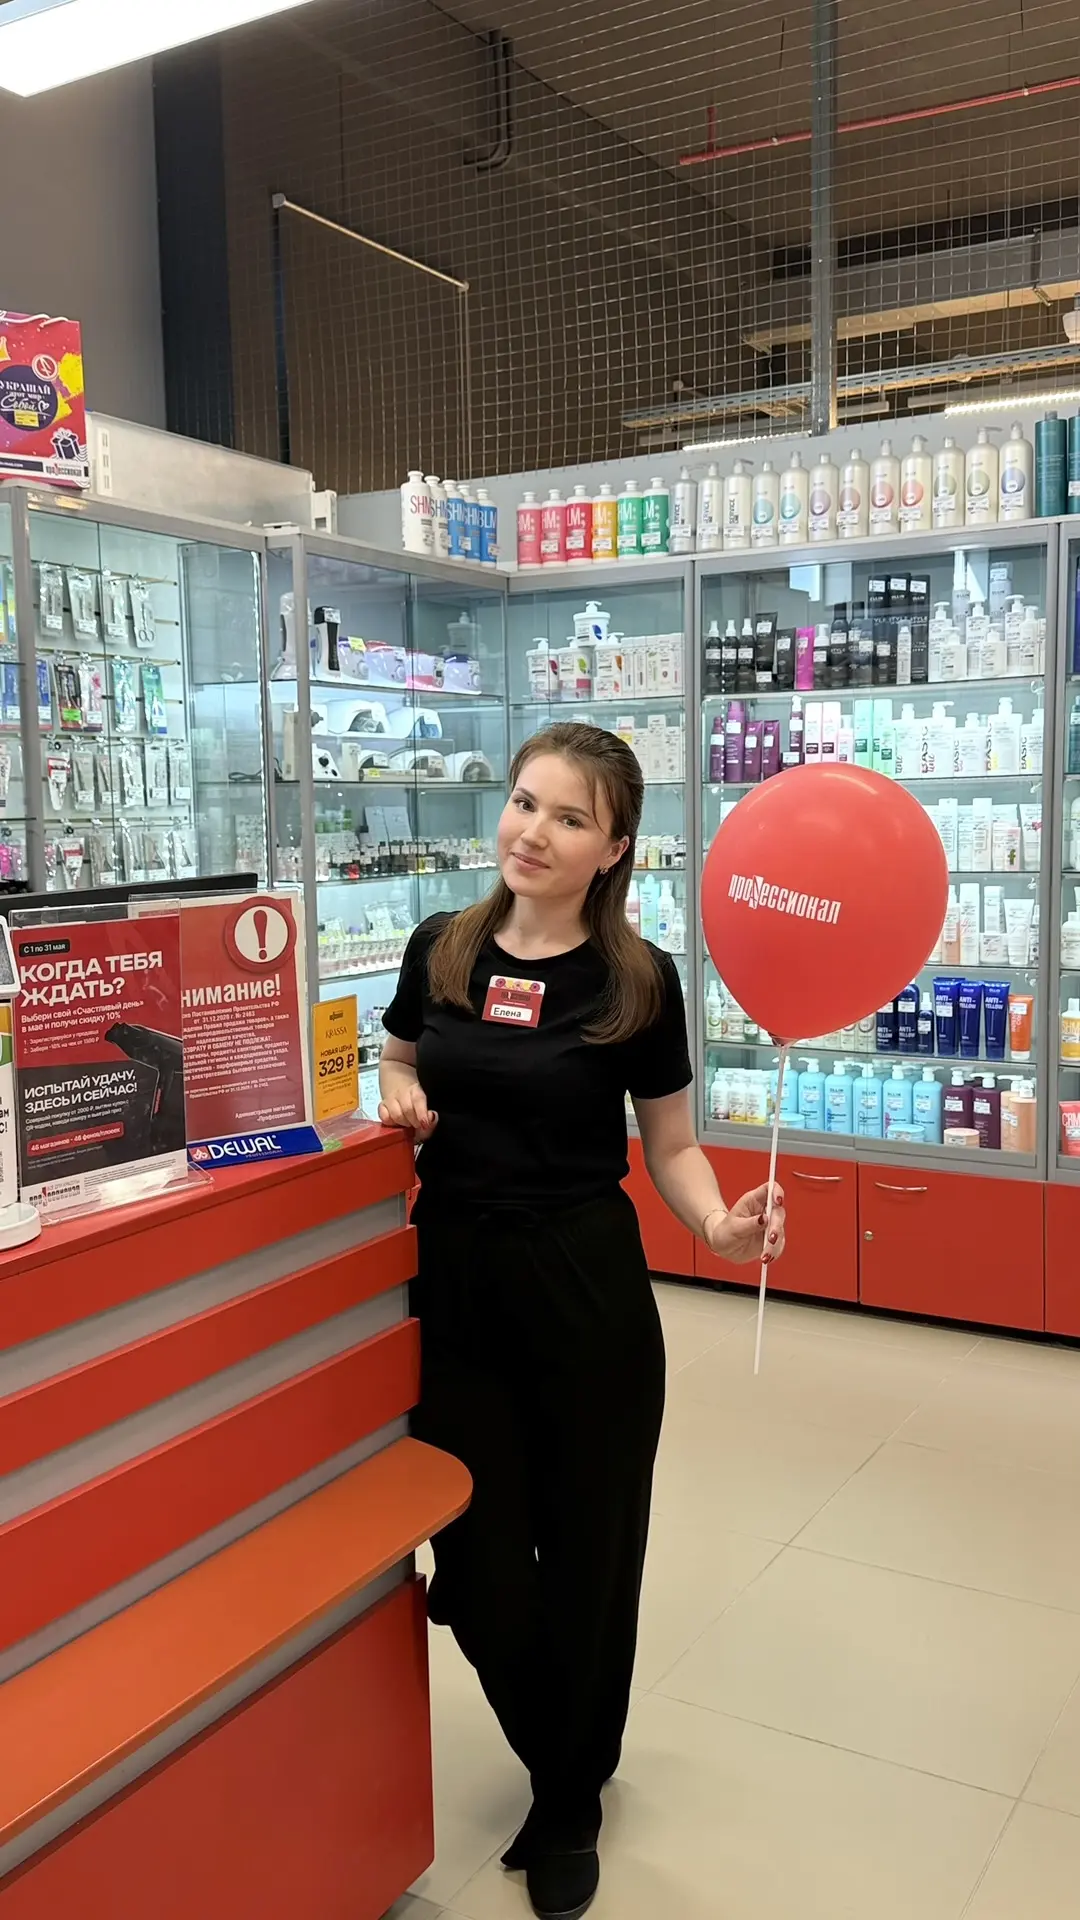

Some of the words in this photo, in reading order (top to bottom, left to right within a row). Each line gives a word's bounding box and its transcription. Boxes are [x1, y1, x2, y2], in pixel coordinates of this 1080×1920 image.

[20, 957, 103, 984] КОГДА
[105, 950, 163, 973] ТЕБЯ
[20, 976, 125, 1007] ЖДАТЬ?
[181, 973, 281, 1008] нимание!
[21, 1012, 52, 1023] Выбери
[53, 1009, 72, 1019] свой
[122, 1000, 144, 1010] день»
[28, 1023, 44, 1032] мае
[51, 1019, 78, 1028] получи
[79, 1014, 106, 1024] скидку
[106, 1011, 121, 1020] 10%
[493, 1007, 522, 1018] Елена
[183, 1044, 206, 1054] ОЗВРАТУ
[320, 1047, 339, 1058] НОВАЯ
[339, 1043, 353, 1055] ЦЕНА
[319, 1056, 344, 1078] 329
[346, 1053, 355, 1069] ₽
[24, 1075, 92, 1099] ИСПЫТАЙ
[91, 1069, 136, 1087] УДАЧУ,
[24, 1096, 71, 1114] ЗДЕСЬ
[71, 1093, 82, 1105] И
[83, 1082, 138, 1101] СЕЙЧАС!
[207, 1135, 282, 1160] DEWAL
